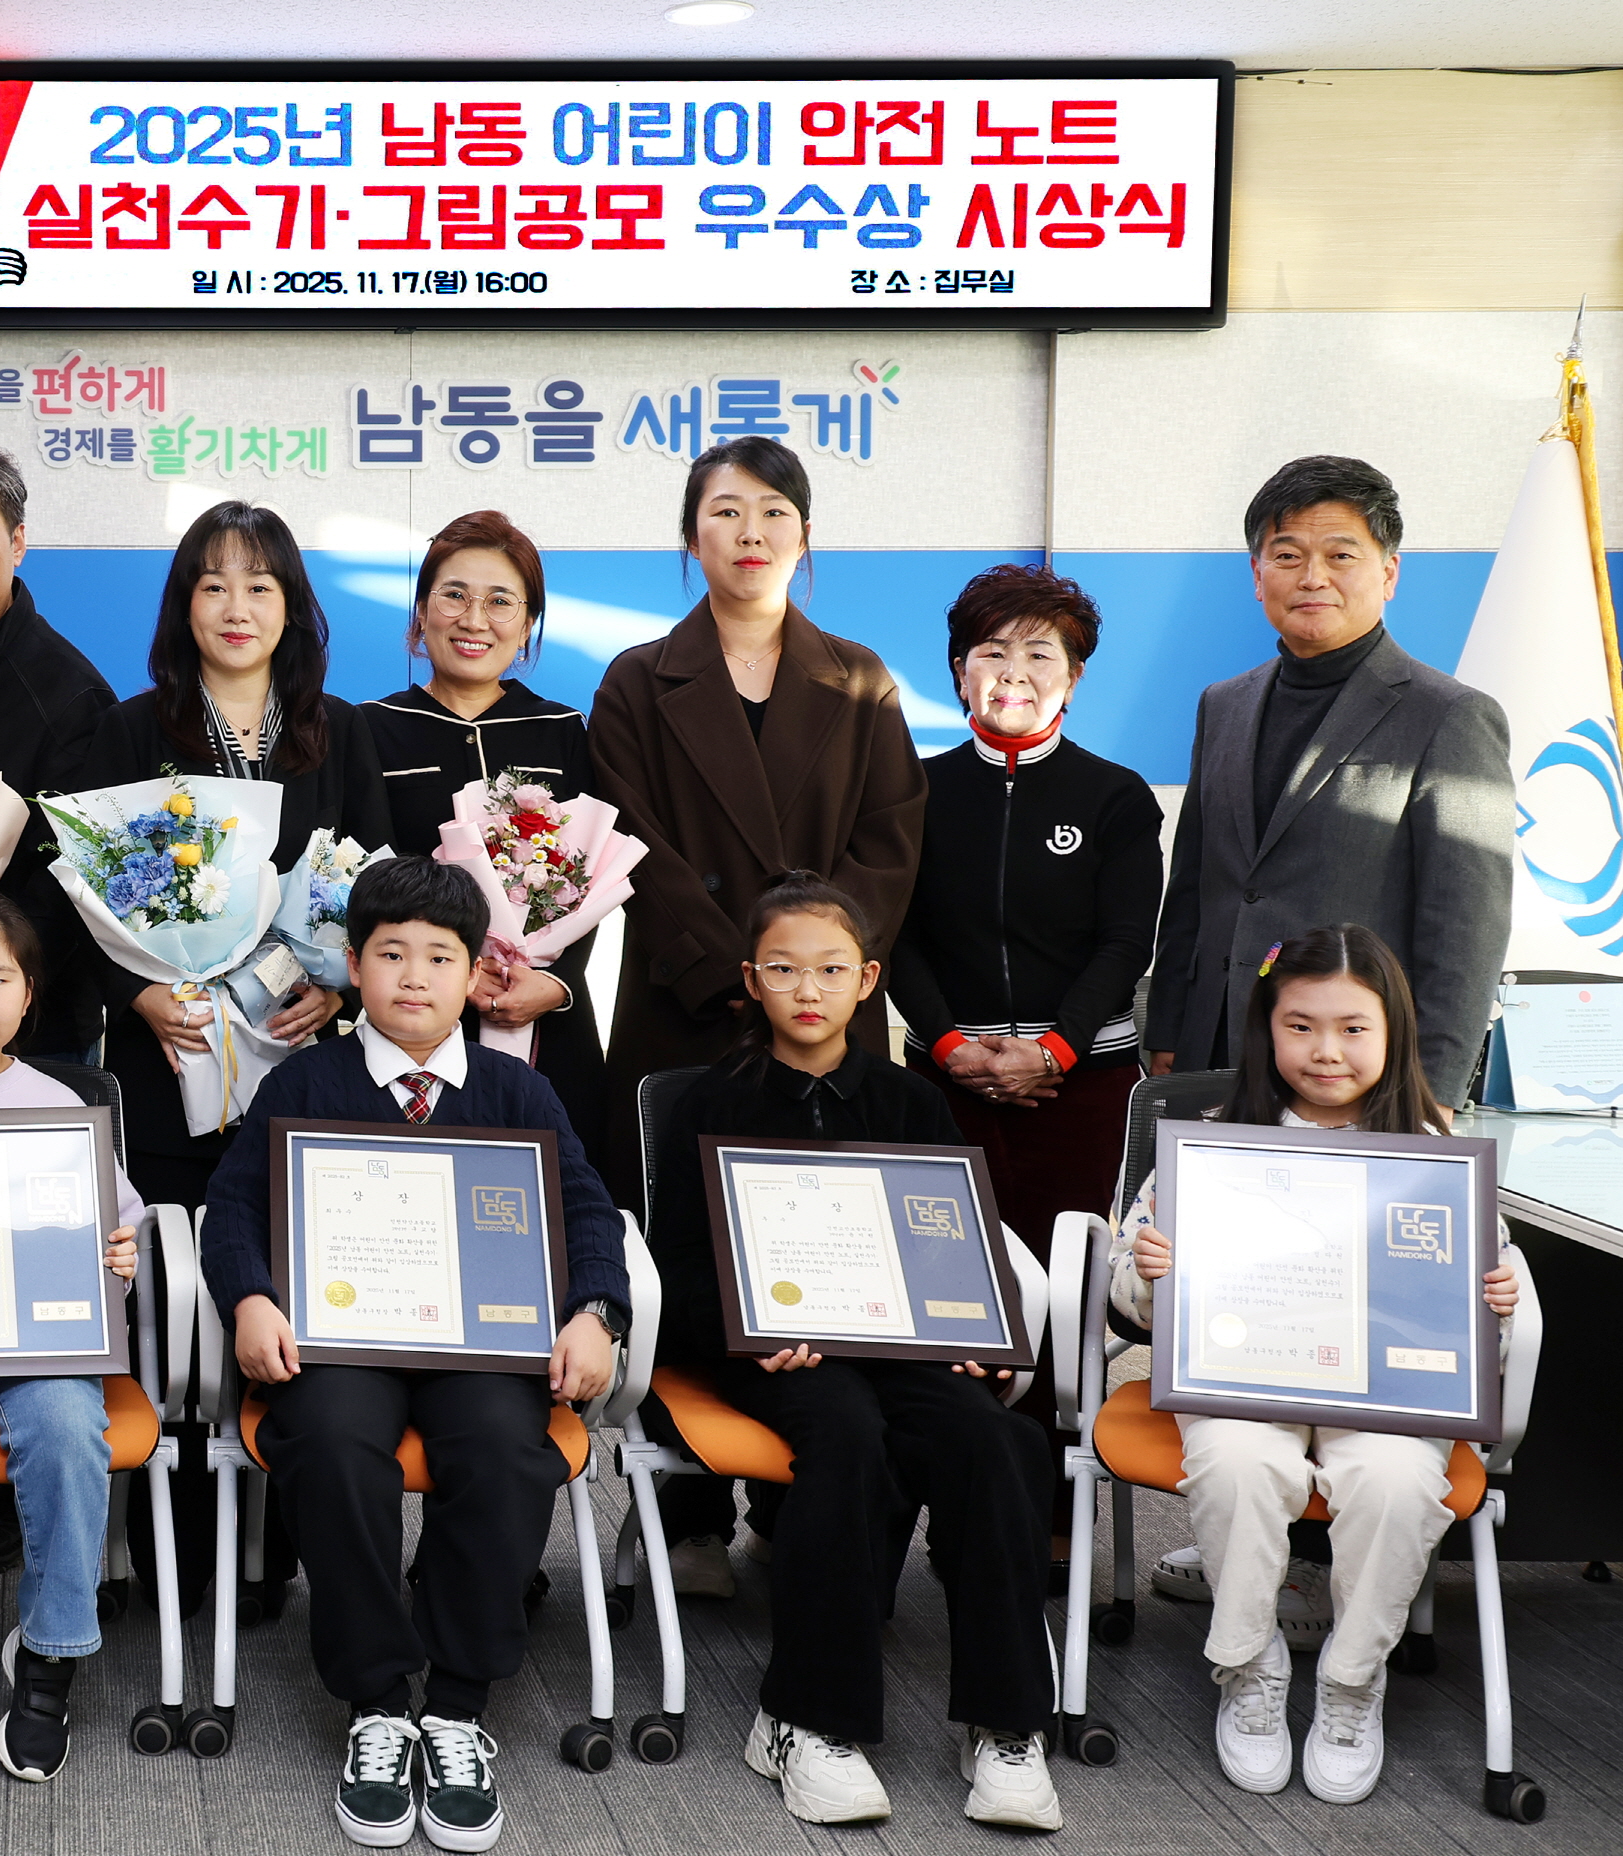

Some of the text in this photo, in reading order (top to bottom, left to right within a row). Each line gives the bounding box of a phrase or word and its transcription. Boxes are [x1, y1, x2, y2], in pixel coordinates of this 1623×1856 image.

[90, 101, 1119, 167] 2025년 남동 어린이 안전 노트
[23, 183, 1186, 251] 실천수기·그림공모 우수상 시상식
[193, 270, 217, 293] 일
[227, 270, 252, 294] 시
[274, 271, 348, 294] 2025.
[358, 272, 383, 294] 11.
[476, 272, 547, 293] 16:00
[851, 270, 878, 293] 장
[885, 270, 911, 293] 소
[935, 270, 1014, 293] 집무실
[32, 355, 165, 414] 편하게
[357, 380, 603, 463] 남동을
[44, 416, 327, 475] 경제를 활기차게
[351, 1190, 410, 1204] 상 장
[784, 1200, 844, 1212] 상 장
[1388, 1251, 1432, 1261] NAMDONG
